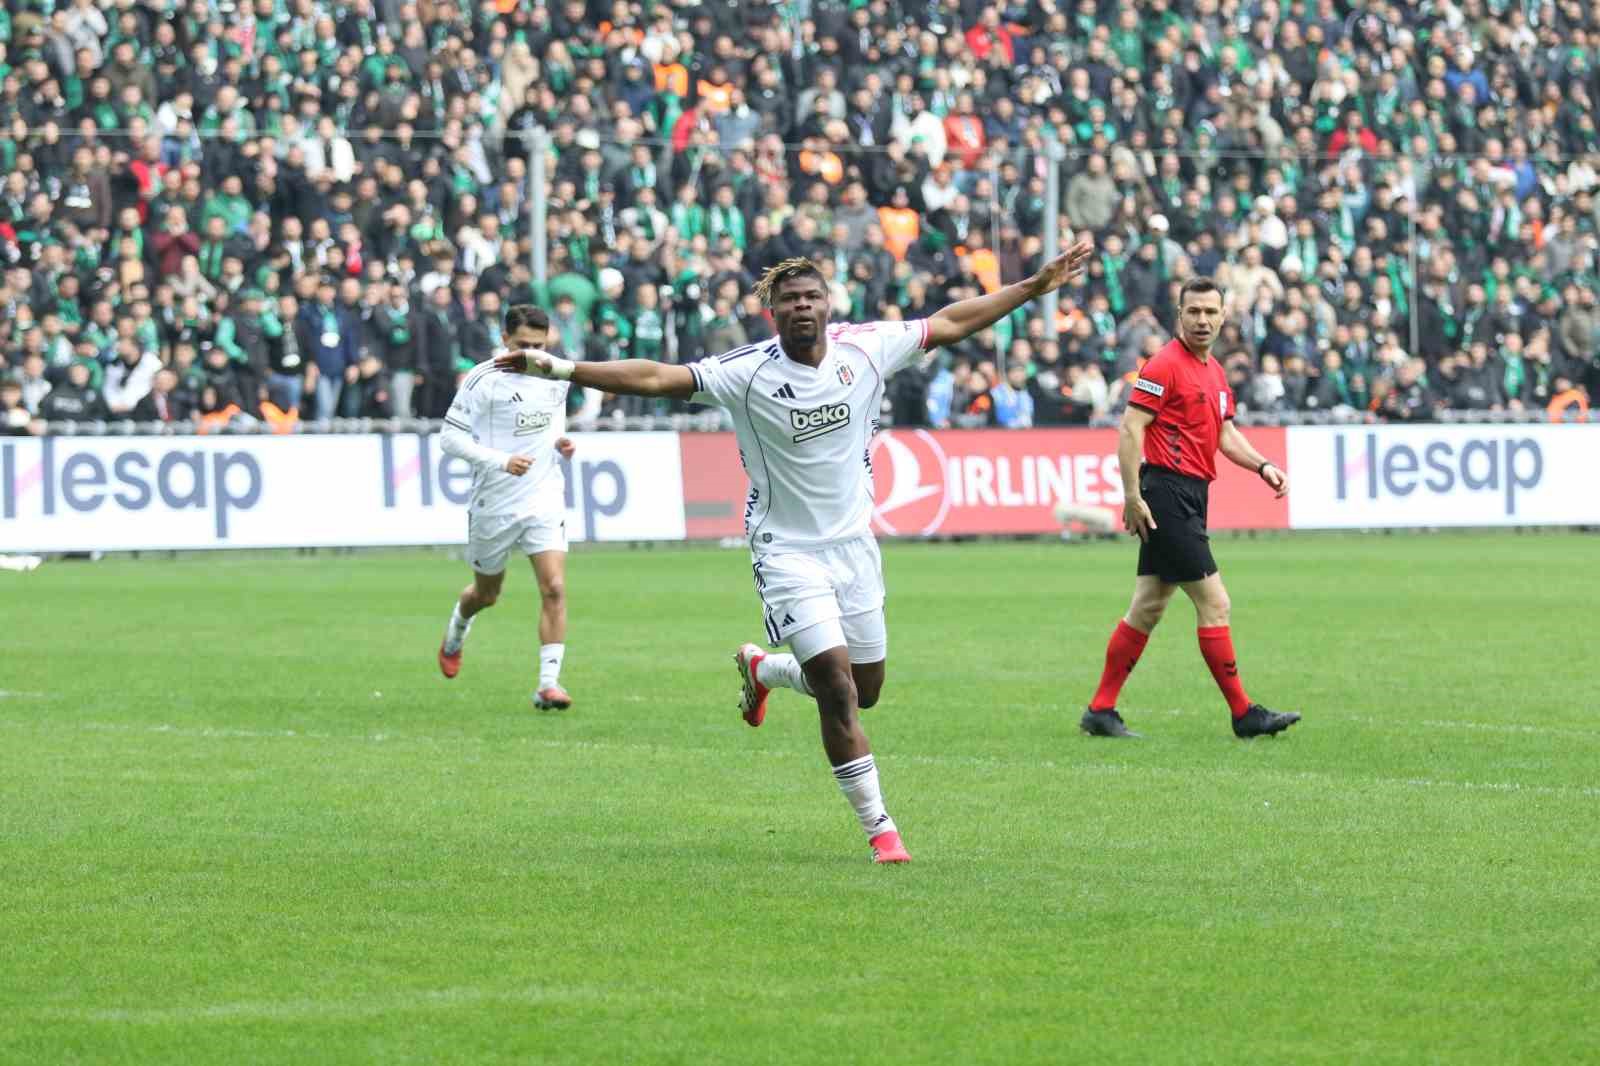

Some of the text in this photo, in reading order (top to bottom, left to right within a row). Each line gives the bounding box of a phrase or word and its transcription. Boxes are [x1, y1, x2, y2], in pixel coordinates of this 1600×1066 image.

[515, 411, 552, 429] beko
[791, 403, 850, 430] beko
[3, 435, 263, 538] Hesap
[382, 433, 627, 541] Hep
[1336, 434, 1543, 514] Hesap
